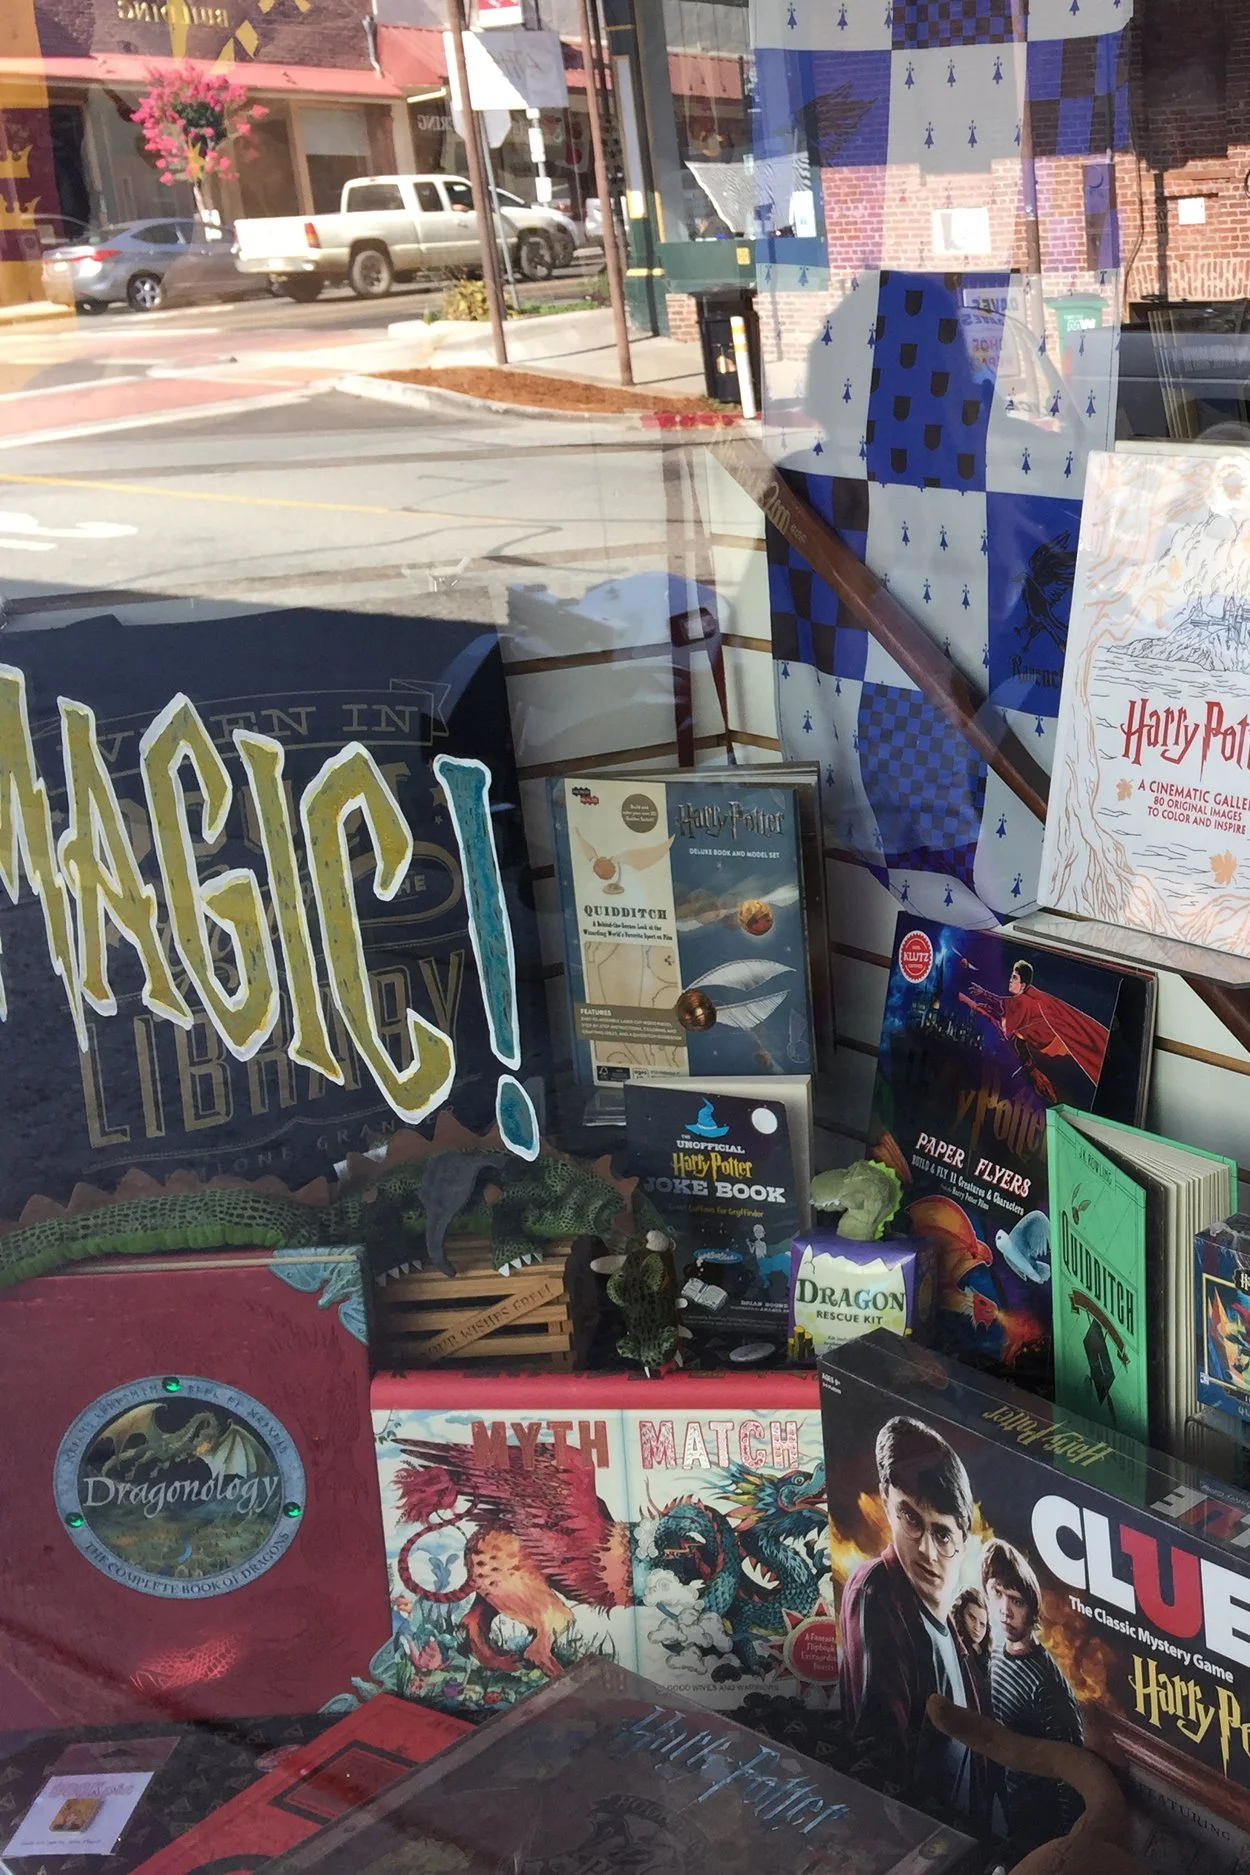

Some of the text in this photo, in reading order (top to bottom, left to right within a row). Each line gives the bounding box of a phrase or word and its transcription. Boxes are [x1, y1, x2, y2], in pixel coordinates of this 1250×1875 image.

[342, 704, 418, 732] IN
[1120, 698, 1199, 766] Harry
[1138, 779, 1146, 791] A
[1149, 781, 1210, 804] CINEMATIC
[677, 801, 785, 840] Harry Potter
[1147, 806, 1246, 835] TO COLOR AND INSPIRE
[1153, 796, 1242, 822] 80 ORIGINAL IMAGES
[689, 848, 712, 856] DELUXE
[746, 851, 768, 859] MODEL
[584, 904, 667, 920] QUIDDITCH
[903, 951, 930, 962] KLUTZ
[580, 1008, 612, 1017] FEATURES
[676, 1140, 745, 1154] UNOFFICIAL
[670, 1152, 752, 1182] Harry Potter
[915, 1132, 1032, 1198] PAPER FLYERS
[643, 1176, 786, 1203] JOKE BOOK
[912, 1154, 929, 1172] BUILD
[930, 1164, 936, 1174] &
[936, 1165, 948, 1180] FLY
[958, 1175, 985, 1198] Creatures
[986, 1189, 993, 1200] &
[993, 1192, 1025, 1216] Characters
[1061, 1210, 1134, 1336] QUIDDITCH
[816, 1309, 884, 1325] RESCUE KIT
[472, 1419, 800, 1470] MYTH MATCH
[83, 1471, 280, 1518] Dragonology
[85, 1531, 291, 1594] THE COMPLETE BOOK OF DRAGONS
[1069, 1595, 1234, 1683] The Classic Mystery Game
[719, 1684, 735, 1692] AND
[1128, 1653, 1216, 1743] Harry
